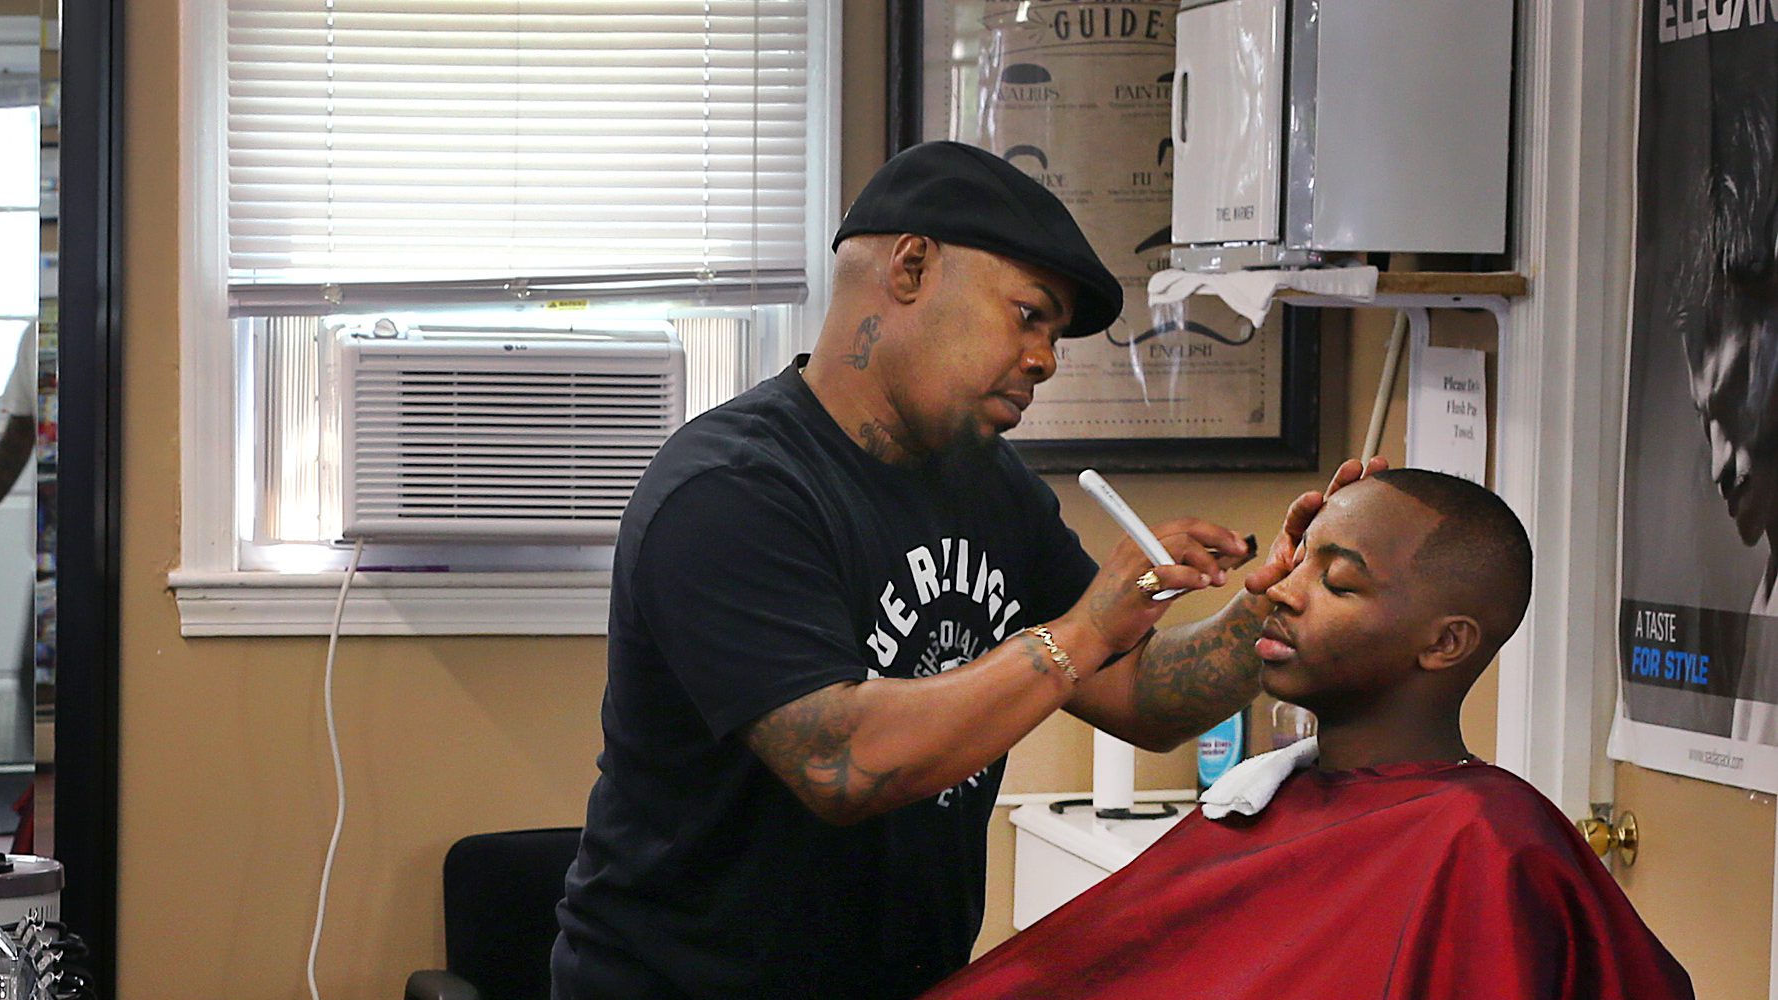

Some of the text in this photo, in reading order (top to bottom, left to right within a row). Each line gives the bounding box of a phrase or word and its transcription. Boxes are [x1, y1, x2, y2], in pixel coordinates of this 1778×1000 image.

[1054, 7, 1162, 41] GUIDE
[1659, 0, 1778, 43] ELEG
[1634, 610, 1677, 643] A TASTE
[1632, 646, 1711, 685] FOR STYLE
